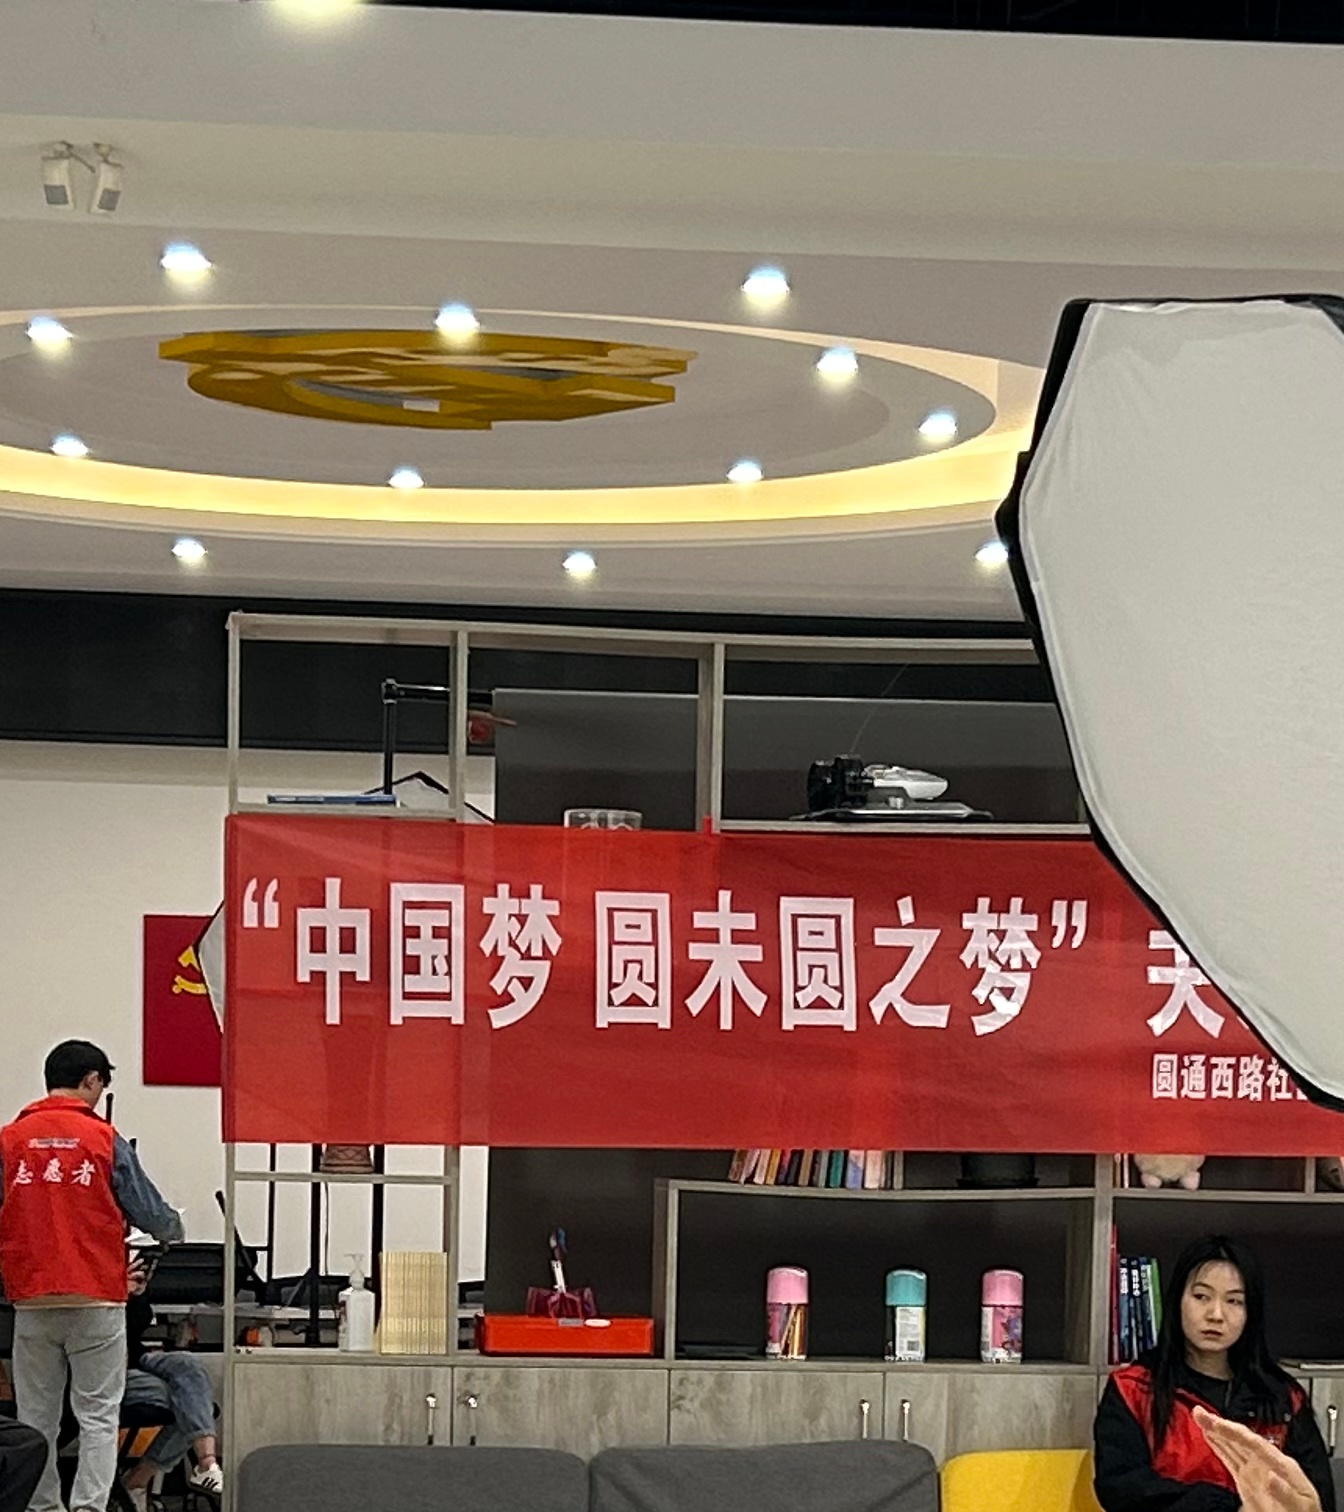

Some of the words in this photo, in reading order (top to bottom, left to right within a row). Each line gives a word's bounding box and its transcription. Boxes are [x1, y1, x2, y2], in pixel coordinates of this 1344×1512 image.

[1146, 930, 1250, 1038] 天
[1152, 1053, 1309, 1101] 圆通西路社
[13, 1158, 96, 1187] 志愿者
